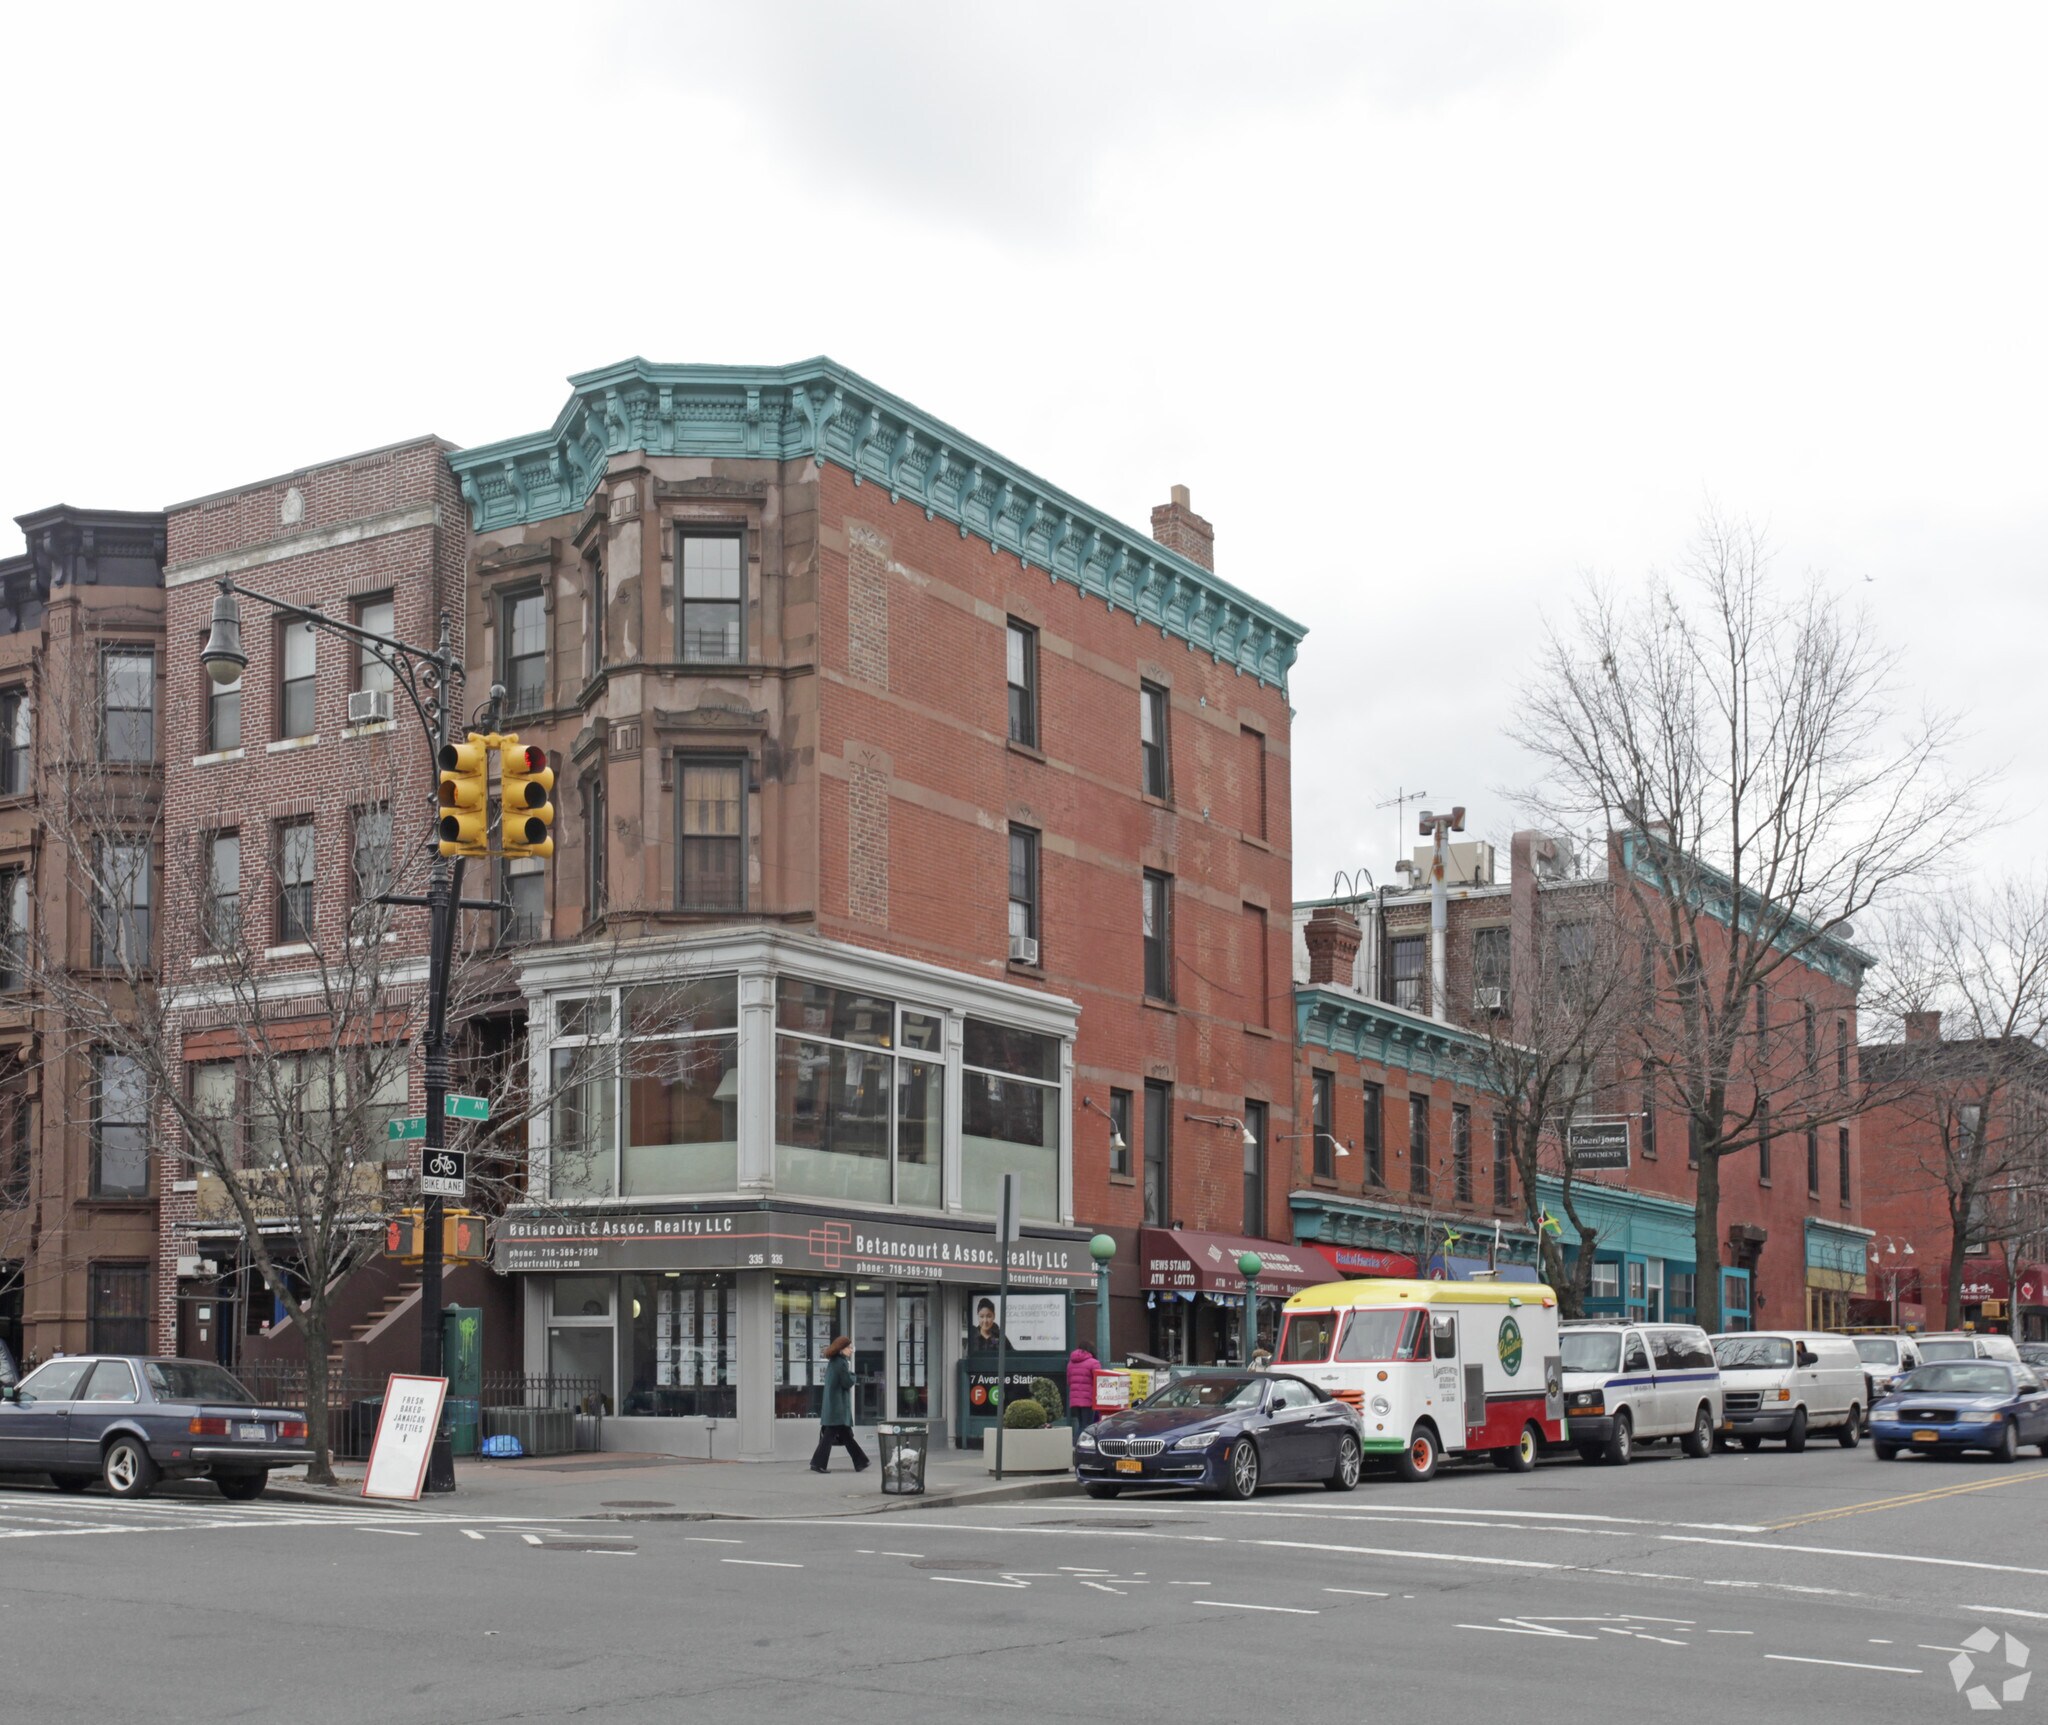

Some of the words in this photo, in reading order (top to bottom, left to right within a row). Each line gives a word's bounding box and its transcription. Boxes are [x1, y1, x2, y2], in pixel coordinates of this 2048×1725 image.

[450, 1097, 459, 1114] 7
[473, 1101, 485, 1111] AV
[410, 1120, 419, 1130] ST
[1577, 1151, 1621, 1160] INVESTMENTS
[424, 1178, 441, 1190] BIKE
[443, 1179, 462, 1192] LANE
[509, 1221, 586, 1237] Betancourt
[589, 1221, 599, 1235] &
[602, 1221, 650, 1235] Assoc.
[654, 1218, 702, 1236] Realty
[706, 1217, 733, 1233] LLC
[509, 1248, 536, 1259] phone:
[541, 1247, 599, 1257] 718-369-7900
[856, 1234, 938, 1260] Betancourt
[942, 1243, 950, 1261] &
[954, 1243, 999, 1264] Assoc.
[1046, 1251, 1068, 1269] LLC
[1259, 1251, 1291, 1263] STAND
[748, 1253, 764, 1265] 335
[771, 1253, 783, 1265] 335
[856, 1262, 884, 1273] phone:
[889, 1264, 943, 1278] 718-369-7900
[1150, 1259, 1169, 1271] NEWS
[1169, 1259, 1191, 1272] STAND
[1009, 1272, 1068, 1286] bcourtrealty.com
[1150, 1273, 1165, 1285] ATM
[1173, 1274, 1196, 1286] LOTTO
[1215, 1278, 1226, 1287] ATM
[970, 1374, 976, 1384] 7
[977, 1374, 1011, 1385] Avene
[1012, 1374, 1037, 1385] Stati
[402, 1396, 424, 1405] FRESH
[974, 1389, 982, 1401] F
[393, 1413, 426, 1423] JAMAICAN
[395, 1423, 423, 1433] PATTIES
